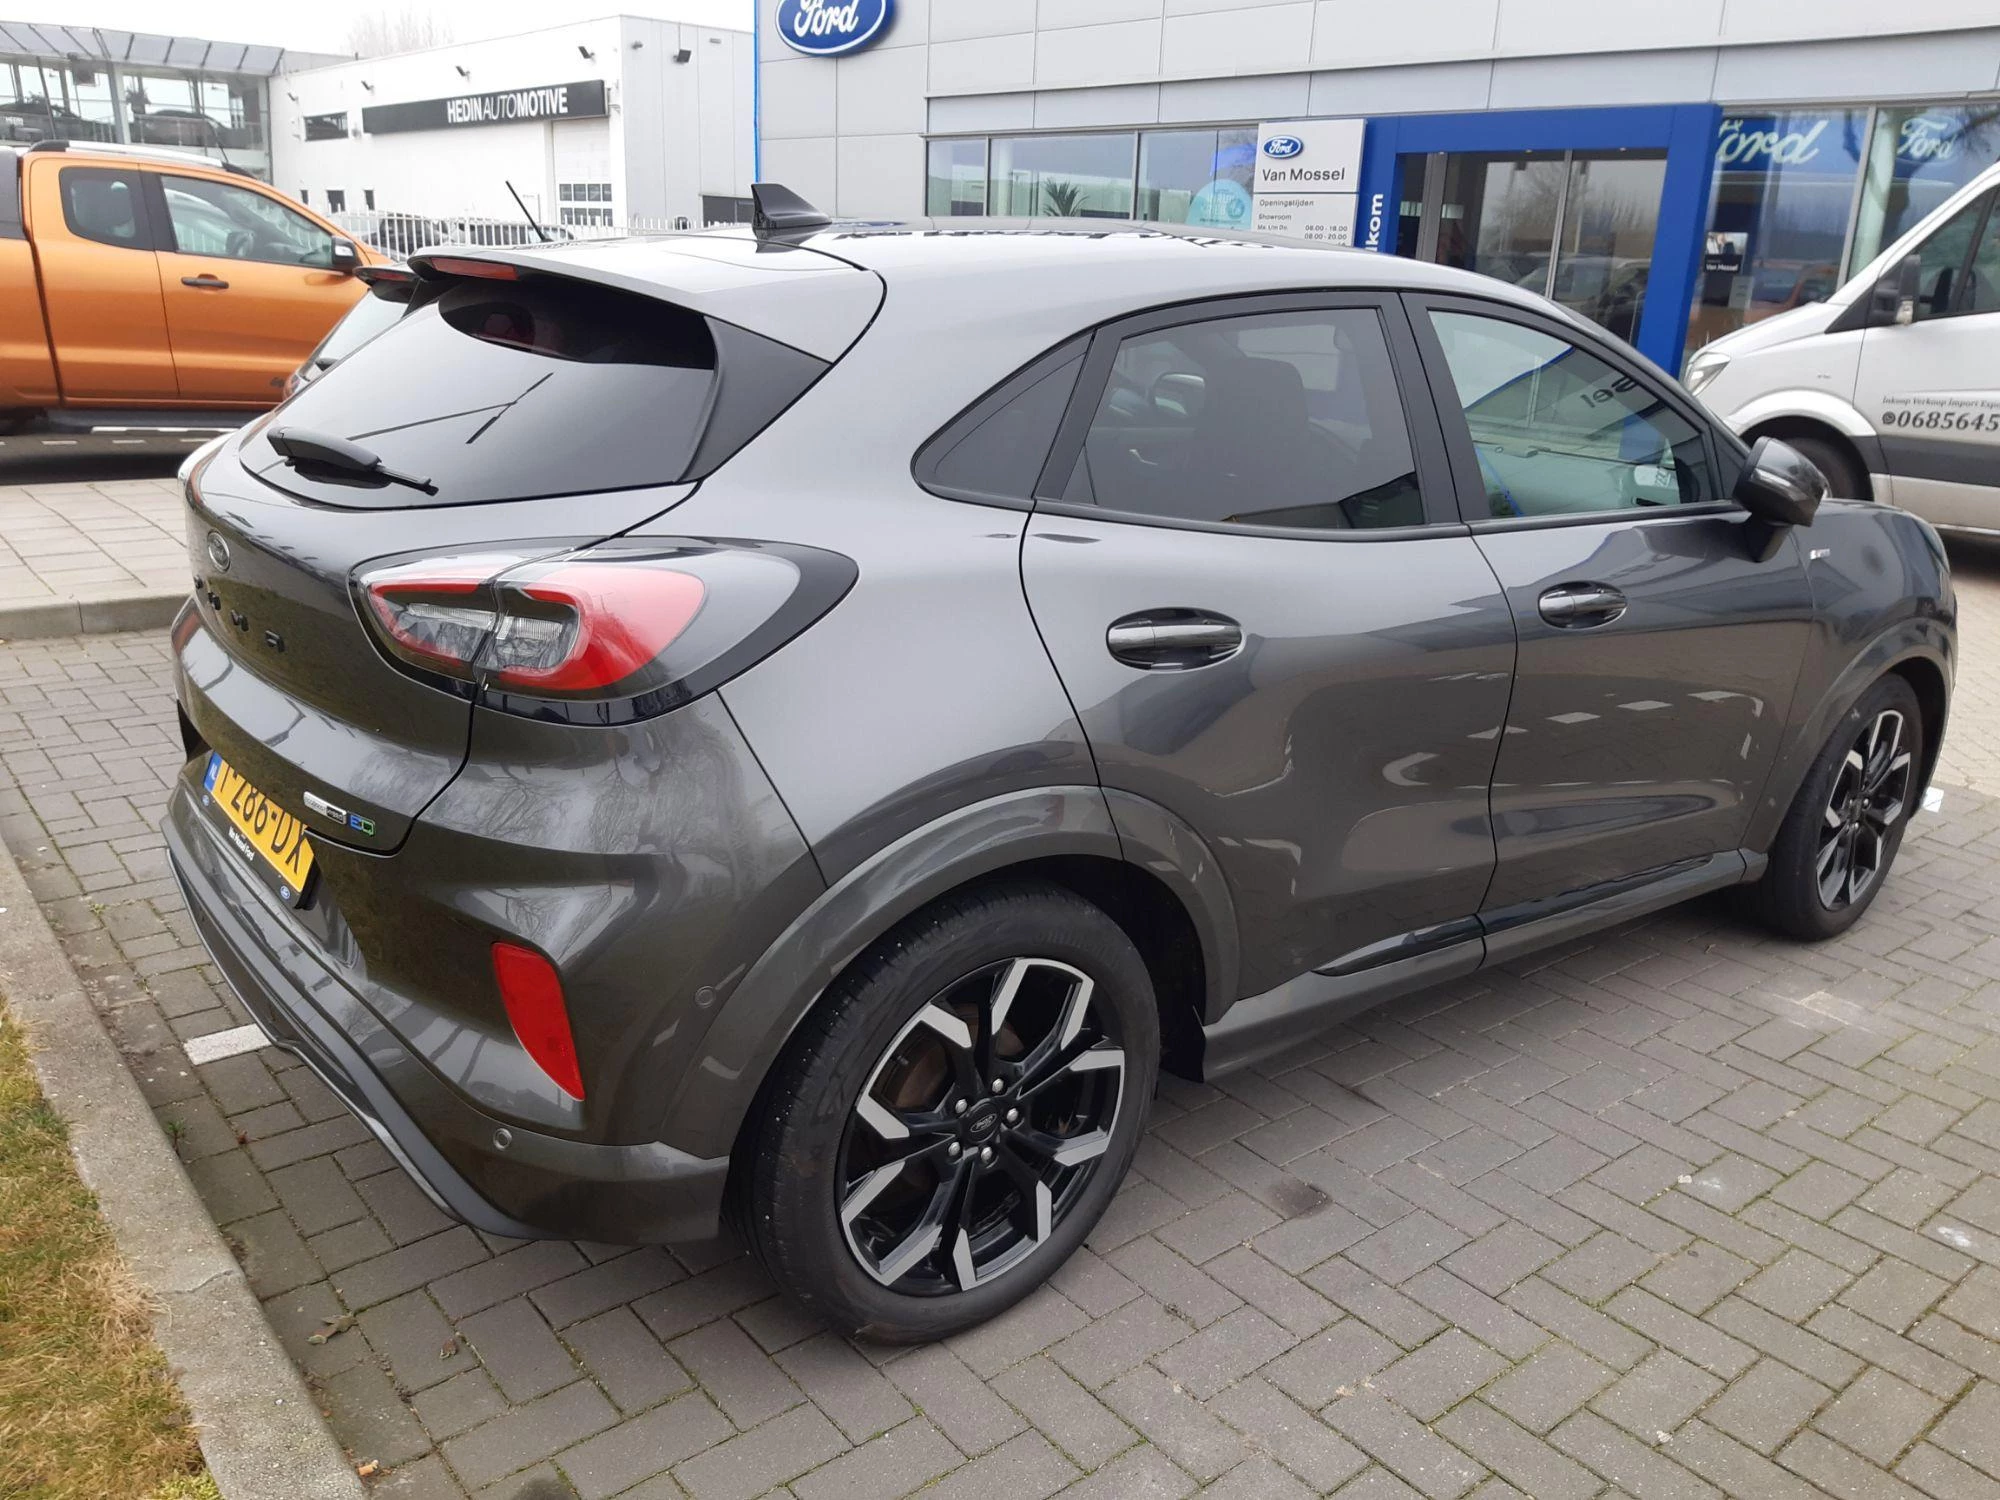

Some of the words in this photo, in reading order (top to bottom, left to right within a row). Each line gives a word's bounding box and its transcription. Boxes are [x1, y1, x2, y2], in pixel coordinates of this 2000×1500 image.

[794, 0, 859, 37] Ford
[1715, 118, 1828, 164] ord
[1897, 117, 1959, 159] Ford
[1268, 139, 1294, 154] Ford
[1262, 168, 1286, 181] Van
[1289, 167, 1345, 181] Mossel
[1259, 199, 1314, 209] Openingstijden
[1258, 213, 1292, 221] Showroom
